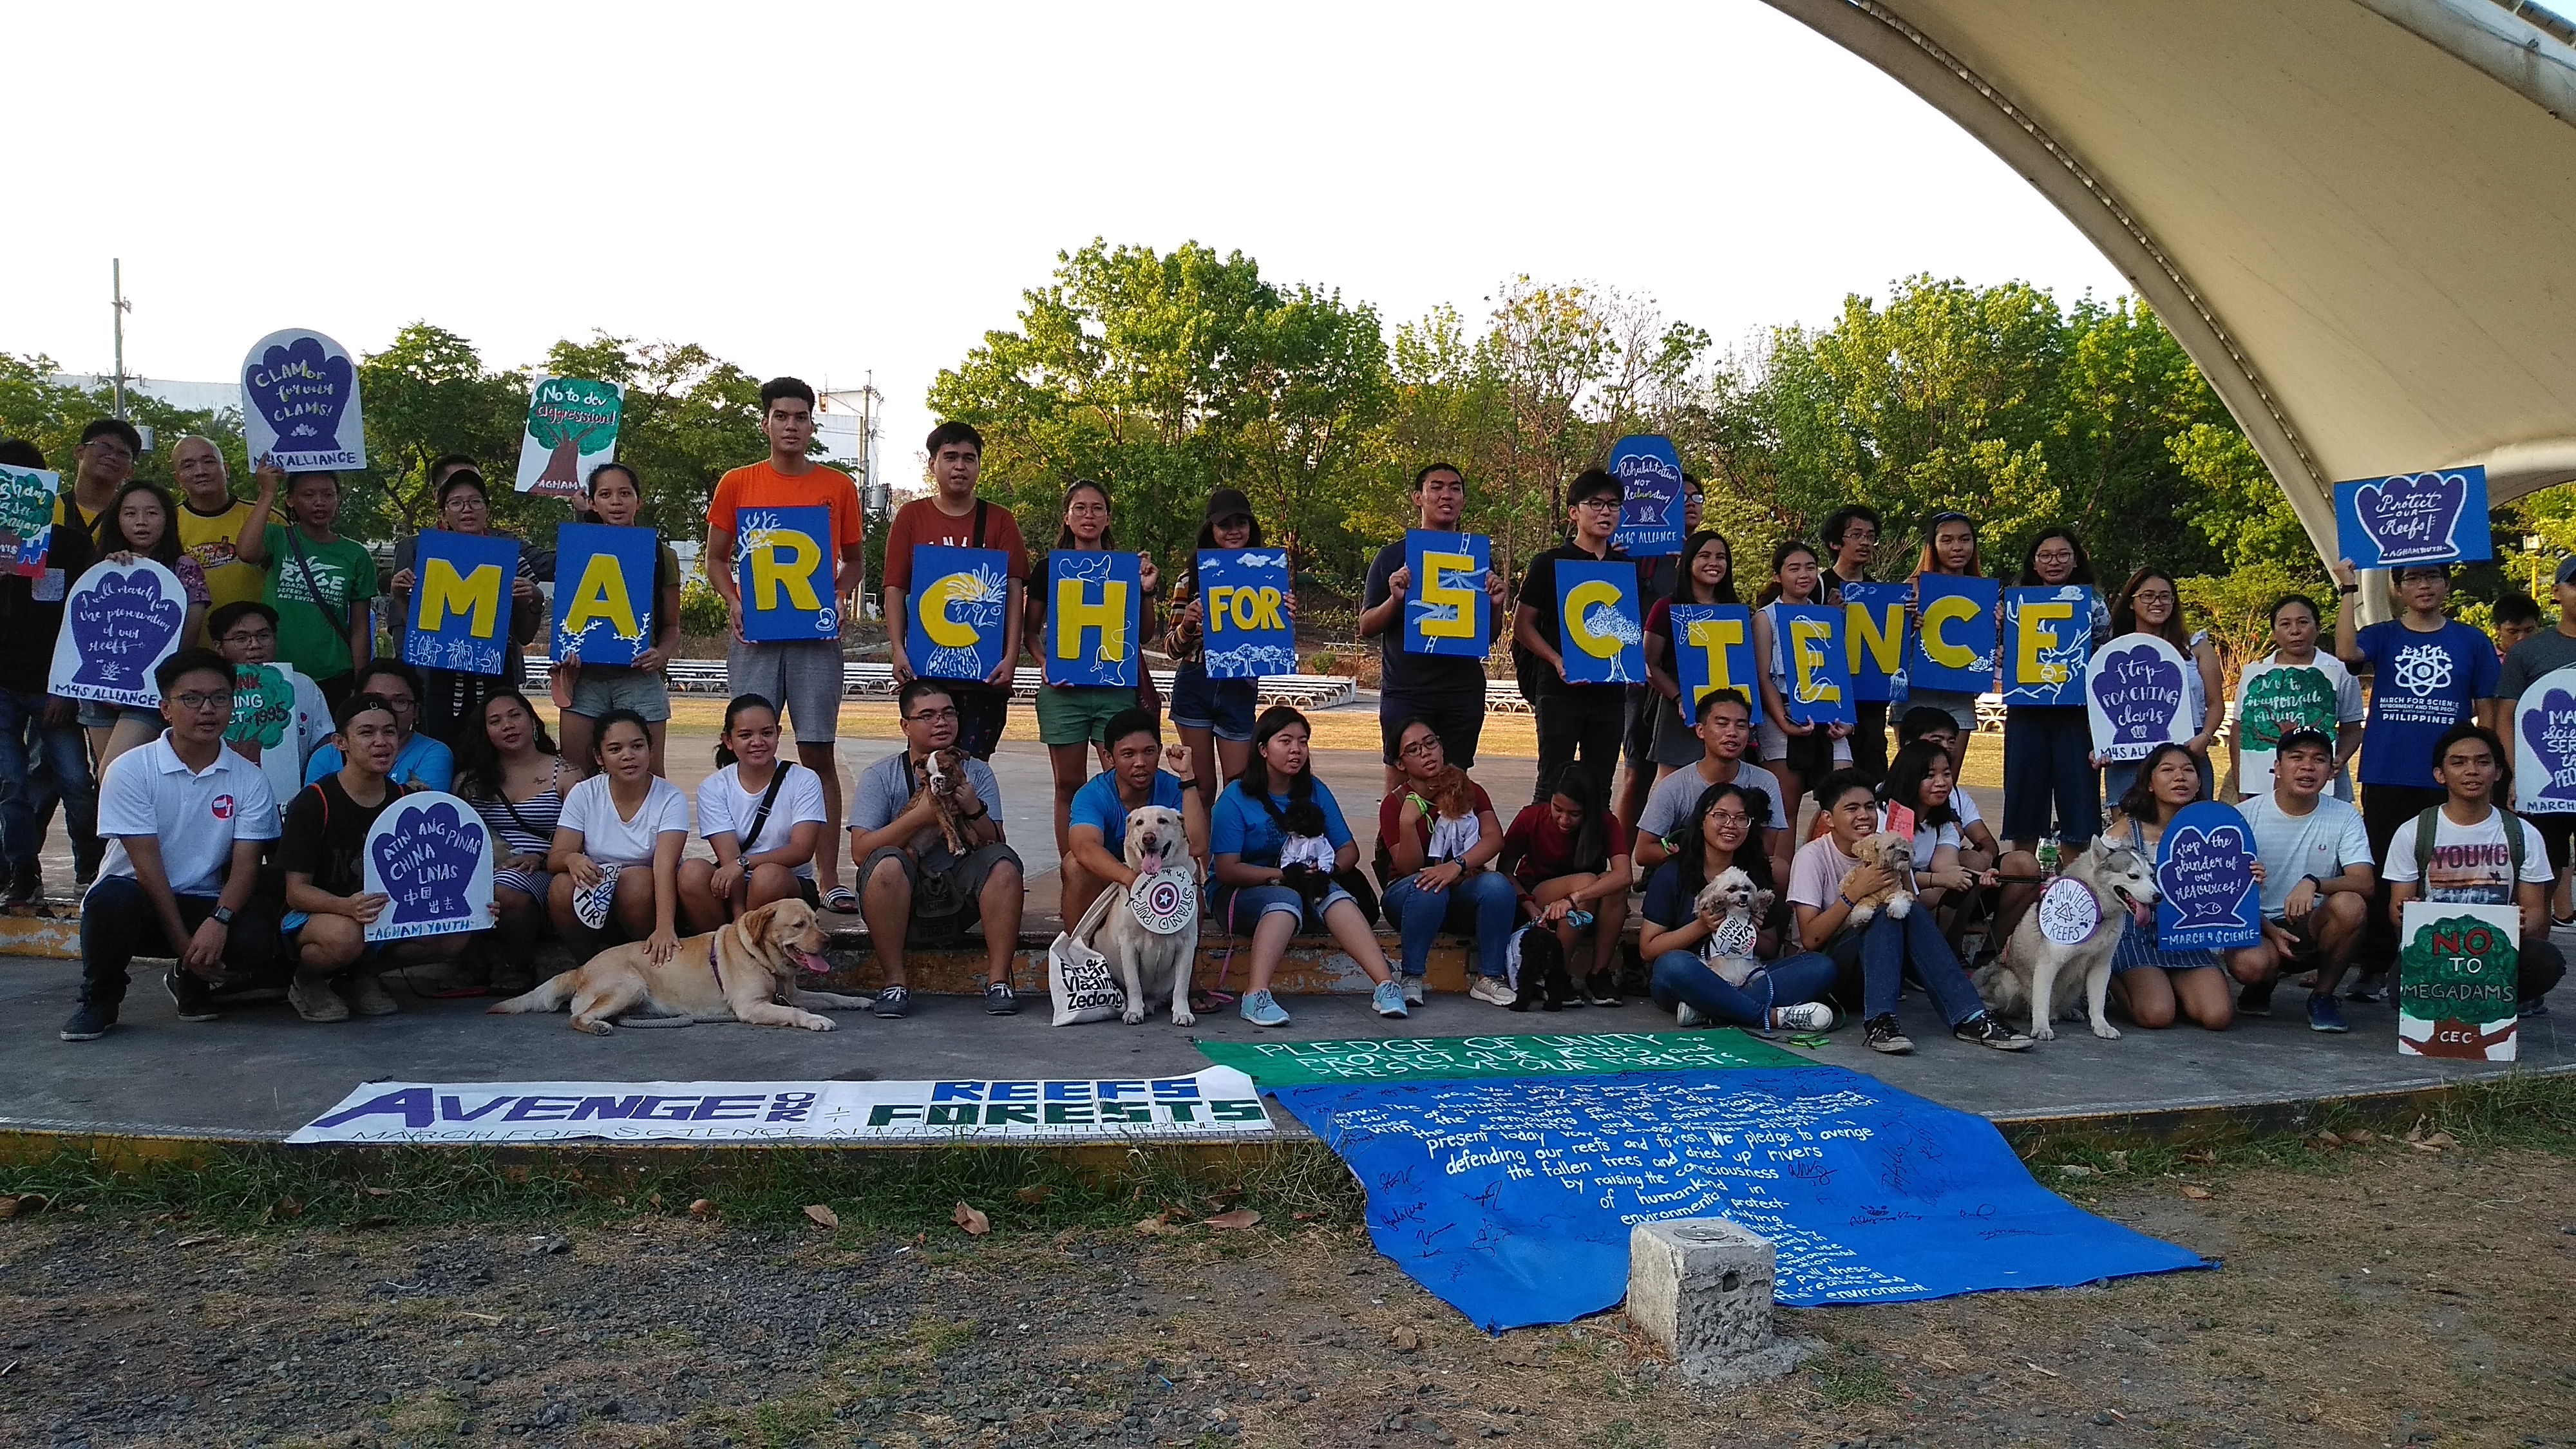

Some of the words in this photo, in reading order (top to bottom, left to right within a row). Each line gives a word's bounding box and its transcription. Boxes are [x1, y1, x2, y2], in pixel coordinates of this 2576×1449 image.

[255, 359, 327, 387] CLAMor
[543, 386, 564, 403] No
[565, 387, 580, 402] to
[583, 392, 607, 406] dev
[274, 401, 333, 422] CLAMS!
[536, 406, 616, 426] aggression!
[287, 451, 357, 466] ALLIANCE
[1620, 460, 1678, 482] Rehabilitation
[2375, 491, 2442, 513] Protect
[1638, 531, 1677, 544] ALLIANCE
[279, 582, 310, 591] AGAINS
[1208, 585, 1285, 632] FOR
[2114, 659, 2166, 685] Stop
[55, 683, 90, 696] M4S
[92, 689, 158, 706] ALLIANCE
[233, 694, 264, 709] ING
[2102, 686, 2179, 708] POACHING
[2427, 699, 2459, 708] SCIENCE
[252, 701, 289, 726] 1995
[2383, 714, 2455, 725] PHILIPPINES
[2527, 802, 2575, 811] MARCH
[383, 828, 412, 861] ATIN
[419, 817, 445, 836] ANG
[444, 829, 481, 855] PINAS
[2176, 841, 2201, 858] stop
[2211, 835, 2233, 848] the
[389, 843, 435, 881] CHINA
[2174, 855, 2222, 881] plunder
[2225, 855, 2239, 871] of
[2432, 844, 2509, 869] YOUNG
[418, 864, 459, 884] LAYAS
[2194, 871, 2213, 882] our
[2175, 878, 2241, 902] resources!
[1132, 900, 1156, 925] PUP
[1158, 887, 1195, 930] STAND
[2041, 907, 2052, 927] OUR
[1718, 917, 1739, 940] HINDI
[2049, 923, 2080, 942] REEFS
[2432, 928, 2493, 956] NO
[2448, 957, 2482, 974] TO
[2402, 983, 2515, 1002] MEGADAMS
[1253, 1039, 1449, 1057] PLEDGE
[1463, 1036, 1517, 1050] OF
[1531, 1034, 1663, 1045] UNITY
[1295, 1052, 1455, 1068] PROTECT
[1553, 1046, 1651, 1059] REEFS
[1668, 1044, 1715, 1054] and
[1517, 1059, 1599, 1071] OUR
[931, 1077, 1202, 1102] REEFS
[308, 1088, 767, 1128] AVENGE
[764, 1092, 817, 1122] OUR
[867, 1100, 1267, 1126] FORESTS
[351, 1130, 495, 1140] MARCH
[506, 1129, 591, 1139] FOR
[614, 1126, 811, 1138] SCIENCE
[1426, 1130, 1488, 1159] present
[1499, 1130, 1545, 1147] today
[1446, 1146, 1527, 1175] defending
[1535, 1148, 1564, 1160] our
[1571, 1137, 1610, 1154] reefs
[1624, 1135, 1649, 1151] and
[1744, 1130, 1794, 1150] pledge
[1795, 1127, 1814, 1141] to
[1820, 1126, 1874, 1142] avenge
[1506, 1162, 1535, 1181] the
[1542, 1160, 1593, 1177] fallen
[1601, 1153, 1643, 1168] trees
[1653, 1150, 1679, 1168] and
[1685, 1144, 1723, 1159] dried
[1732, 1150, 1752, 1166] up
[1767, 1146, 1823, 1162] rivers
[1560, 1176, 1584, 1195] by
[1593, 1171, 1645, 1191] raising
[1644, 1170, 1669, 1184] the
[1674, 1161, 1780, 1180] consciousness
[1600, 1188, 1616, 1209] of
[1745, 1182, 1766, 1195] in
[1620, 1191, 1721, 1226] environmenta
[1828, 1265, 1871, 1276] these
[1826, 1282, 1933, 1300] environment.
